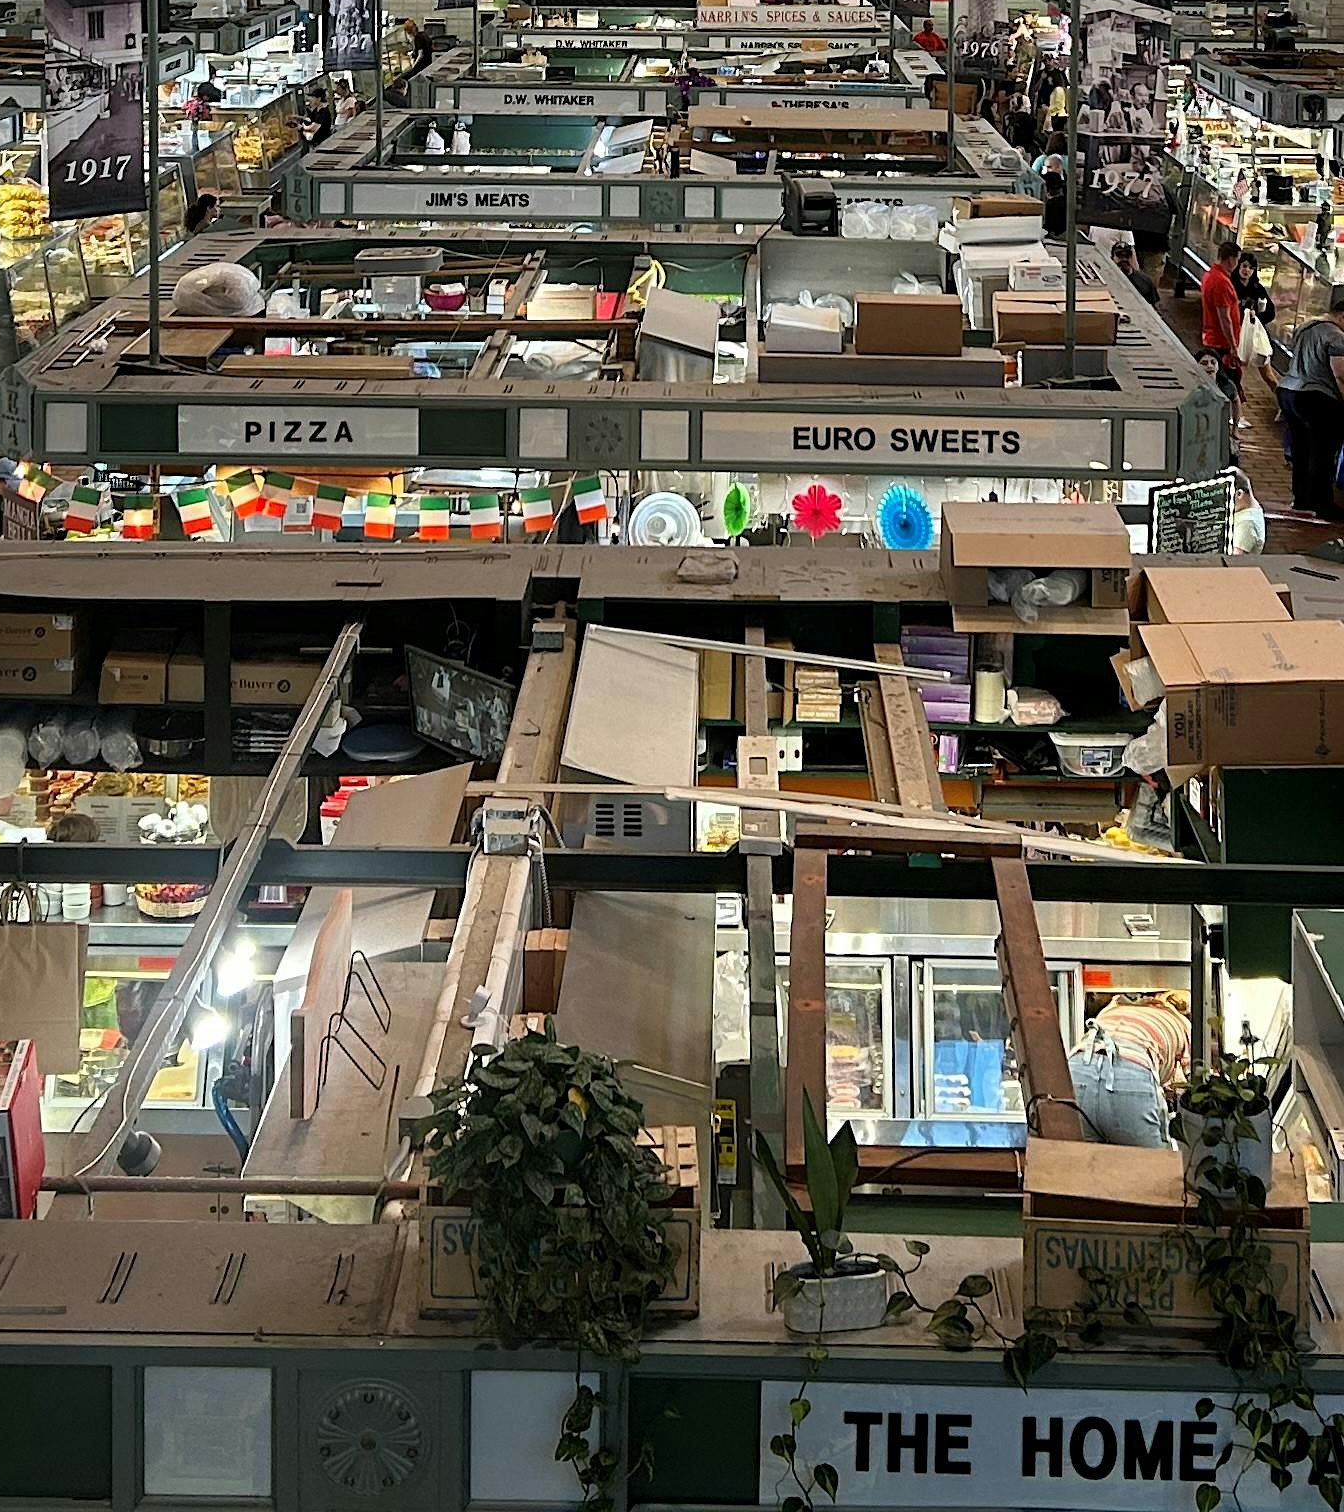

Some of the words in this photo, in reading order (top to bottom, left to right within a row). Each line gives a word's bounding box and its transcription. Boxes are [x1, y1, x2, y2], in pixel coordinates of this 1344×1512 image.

[700, 10, 758, 23] NARRIN'S
[766, 10, 806, 23] SPICES
[812, 10, 821, 23] &
[827, 10, 874, 23] SAUCES
[961, 40, 1000, 58] 1976
[504, 94, 530, 106] D.W.
[534, 94, 595, 107] WHITAKER
[63, 154, 134, 187] 1917
[1090, 167, 1155, 197] 1977
[425, 193, 468, 208] JIM'S
[474, 192, 530, 208] MEATS
[243, 420, 354, 444] PIZZA
[792, 426, 877, 451] EURO
[889, 428, 1022, 455] SWEETS
[1174, 712, 1185, 739] YOU
[1045, 1235, 1202, 1275] RGENTINAS
[843, 1411, 973, 1474] THE
[1021, 1415, 1218, 1483] HOME
